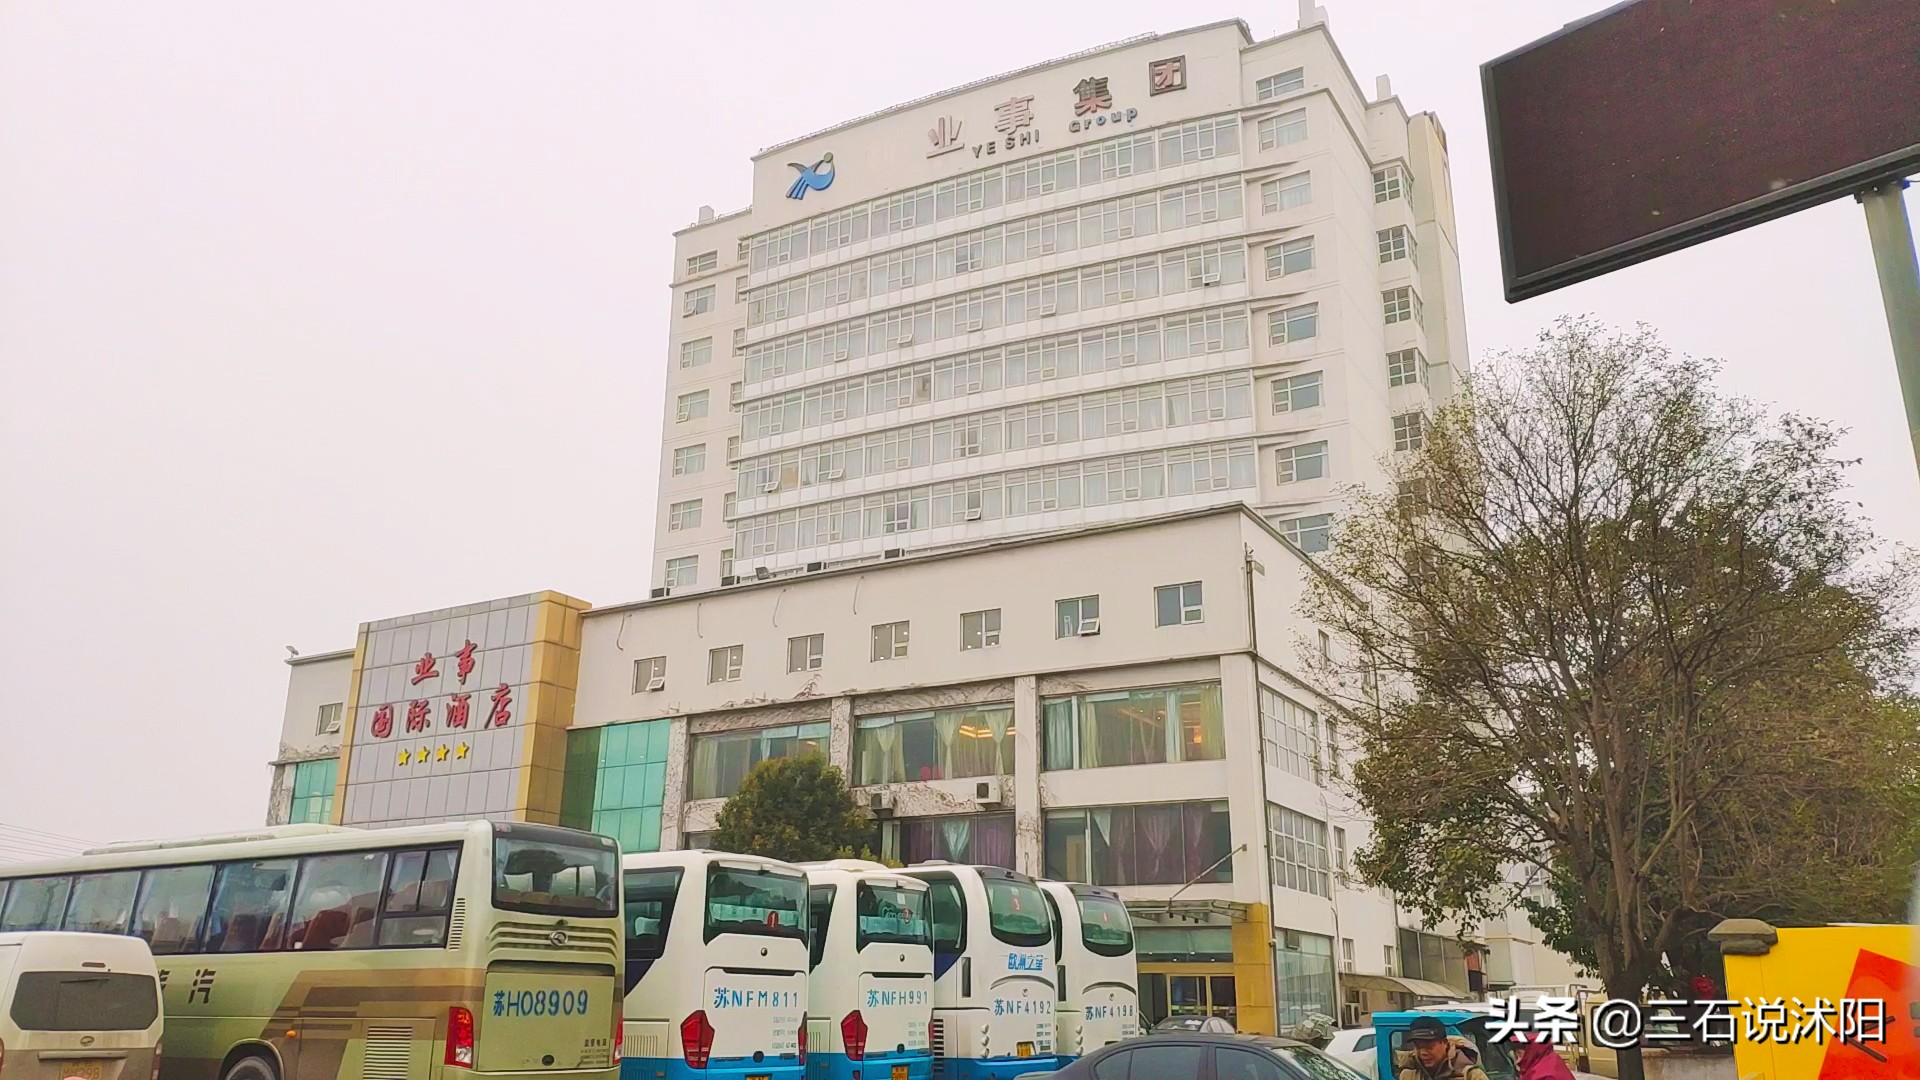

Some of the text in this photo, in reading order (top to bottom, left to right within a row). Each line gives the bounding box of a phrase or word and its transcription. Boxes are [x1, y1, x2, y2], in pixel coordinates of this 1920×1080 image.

[926, 54, 1187, 159] 业事集团
[1068, 107, 1138, 133] Group
[411, 639, 477, 685] 业事
[371, 683, 512, 738] 国际酒店
[493, 989, 589, 1017] 苏H08909
[713, 987, 797, 1009] 苏NFM811
[867, 989, 928, 1008] 苏NFH991
[994, 998, 1051, 1016] 苏NF4192
